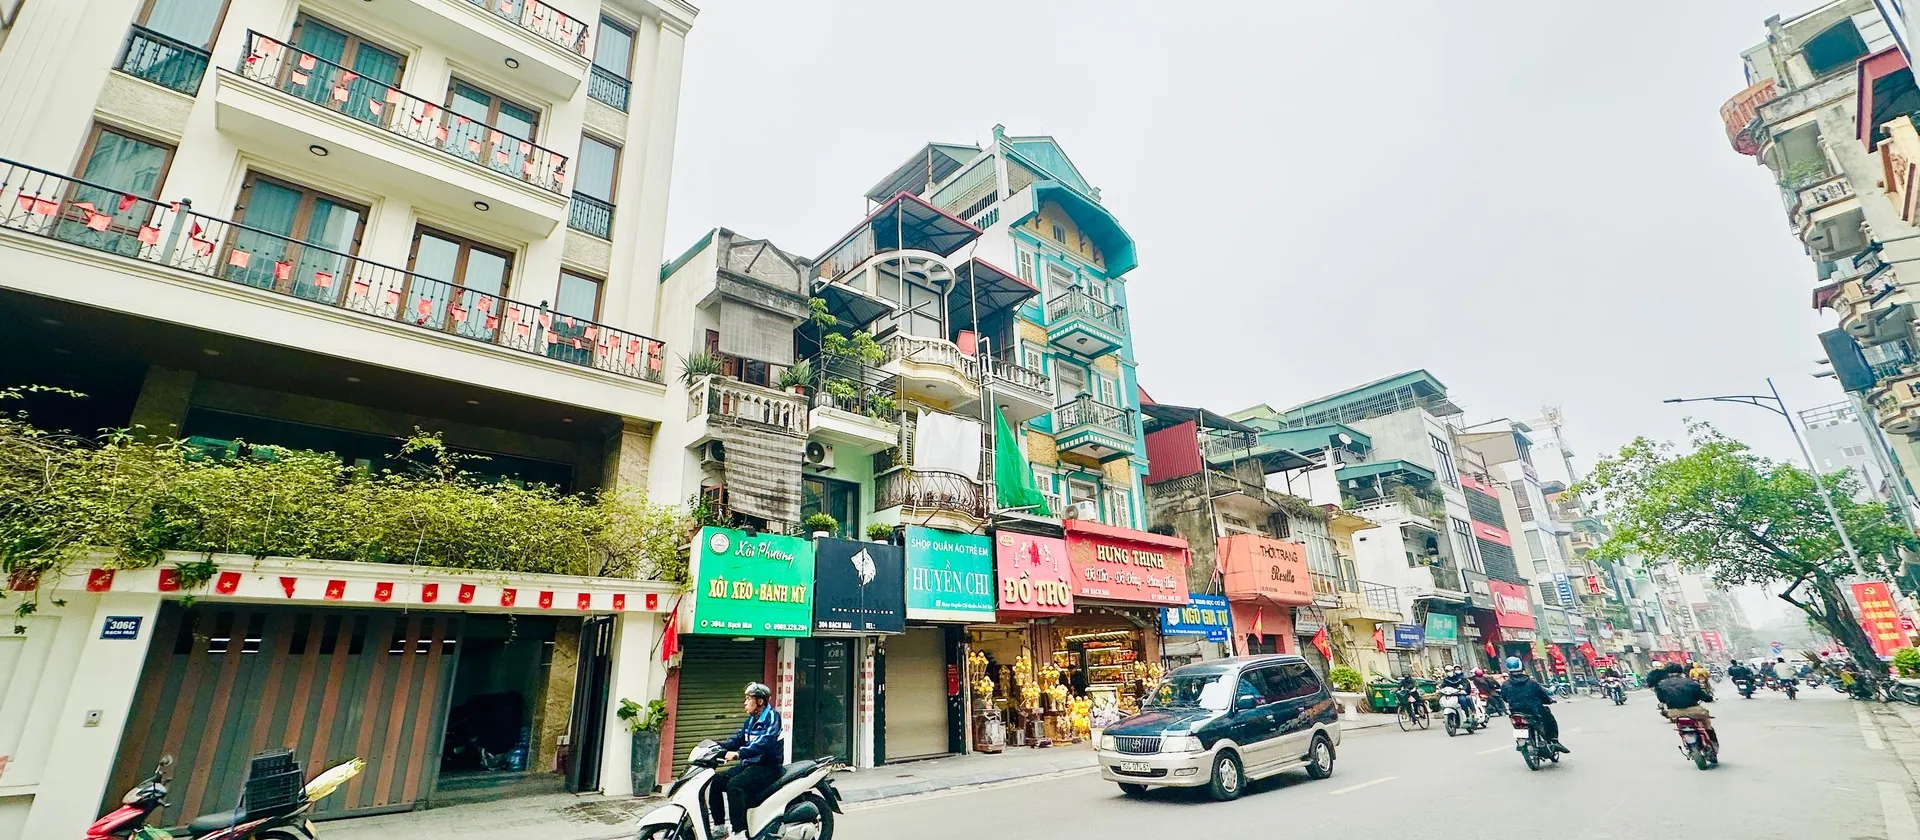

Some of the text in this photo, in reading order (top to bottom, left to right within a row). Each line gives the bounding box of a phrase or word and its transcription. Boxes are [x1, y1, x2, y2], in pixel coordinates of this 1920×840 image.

[735, 540, 755, 557] Xôi
[911, 539, 930, 548] SHOP
[955, 543, 964, 553] ÁO
[978, 547, 988, 556] EM
[1096, 544, 1164, 571] HƯNG THỊNH
[1276, 548, 1298, 563] TRANG
[912, 559, 989, 595] HUYỀN CHI
[708, 574, 728, 598] XÔI
[731, 578, 753, 600] XÉO
[759, 580, 788, 602] BÁNH
[1004, 569, 1072, 607] ĐỒ THỜ
[1182, 605, 1200, 624] NGÔ
[1201, 609, 1217, 625] GIA
[110, 621, 136, 630] 306C
